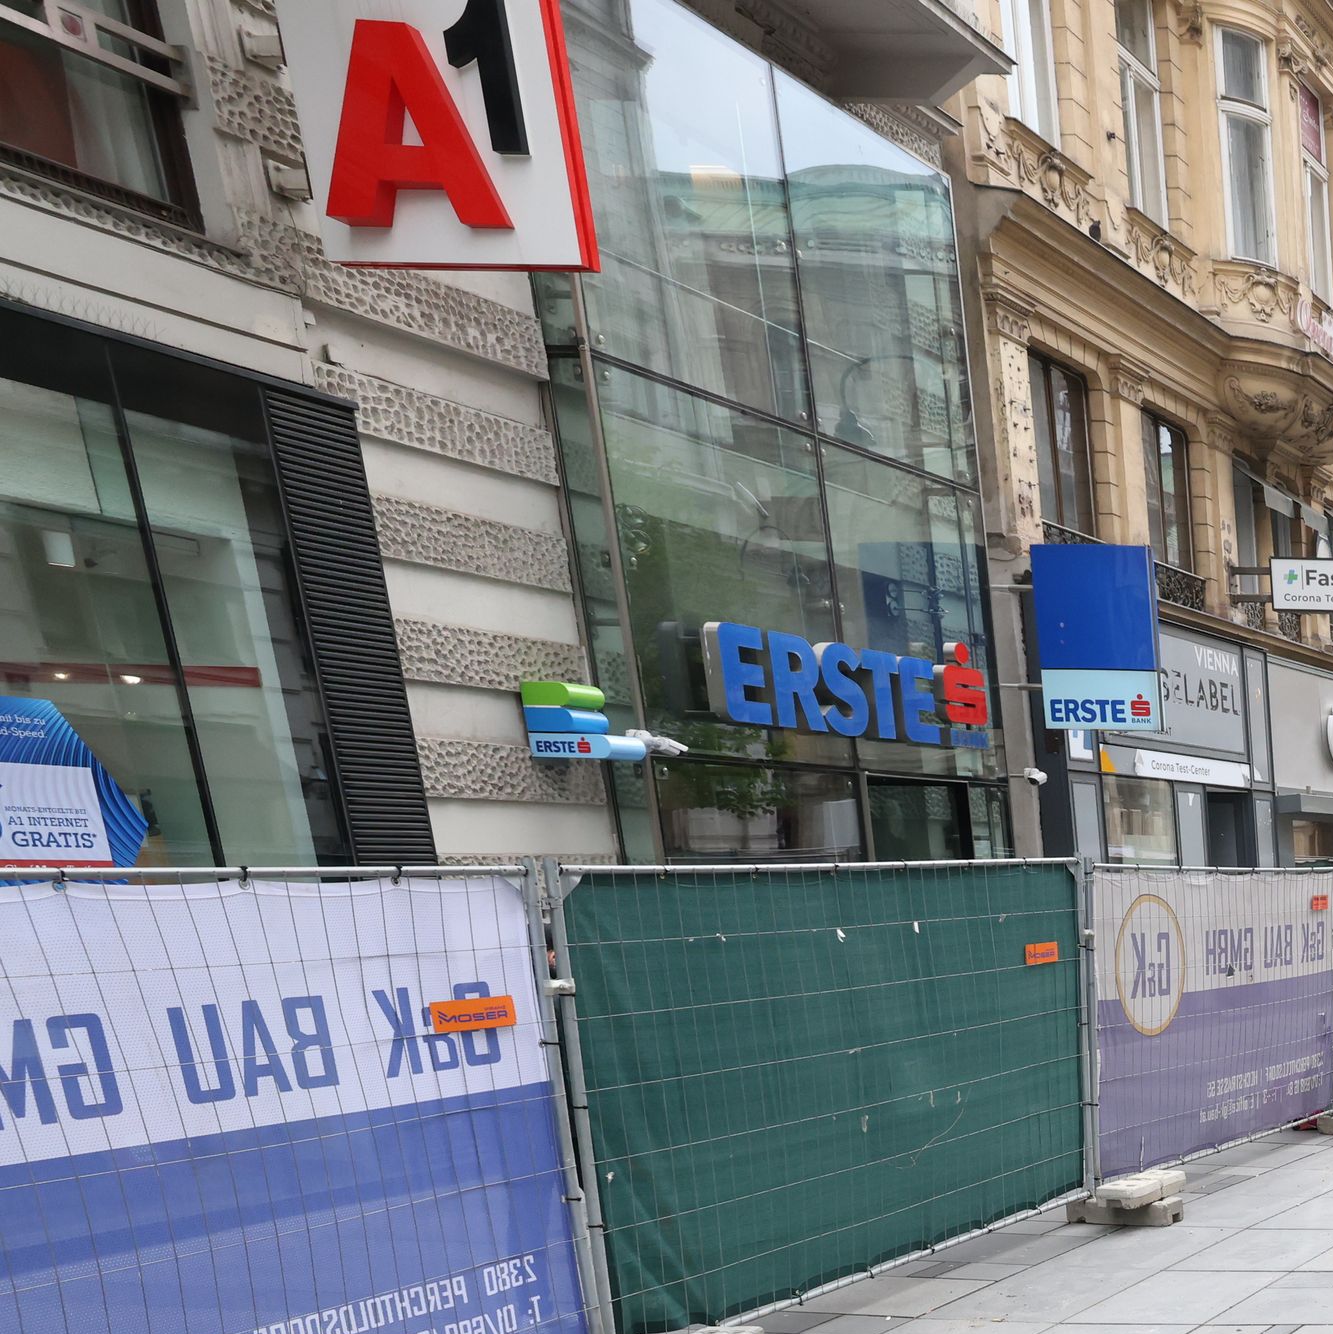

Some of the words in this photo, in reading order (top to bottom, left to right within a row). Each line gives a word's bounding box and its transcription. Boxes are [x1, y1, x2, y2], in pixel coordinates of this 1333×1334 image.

[326, 0, 530, 229] A1
[1284, 592, 1322, 604] Corona
[1194, 645, 1239, 676] VIENNA
[712, 620, 943, 746] ERSTE
[1050, 698, 1126, 723] ERSTE
[1131, 717, 1152, 725] BANK
[536, 740, 576, 753] ERSTE
[1151, 760, 1175, 772] Corona
[1176, 763, 1211, 777] Test-Center
[8, 816, 24, 826] A1
[28, 817, 89, 828] INTERNET
[437, 1010, 508, 1025] MOSER
